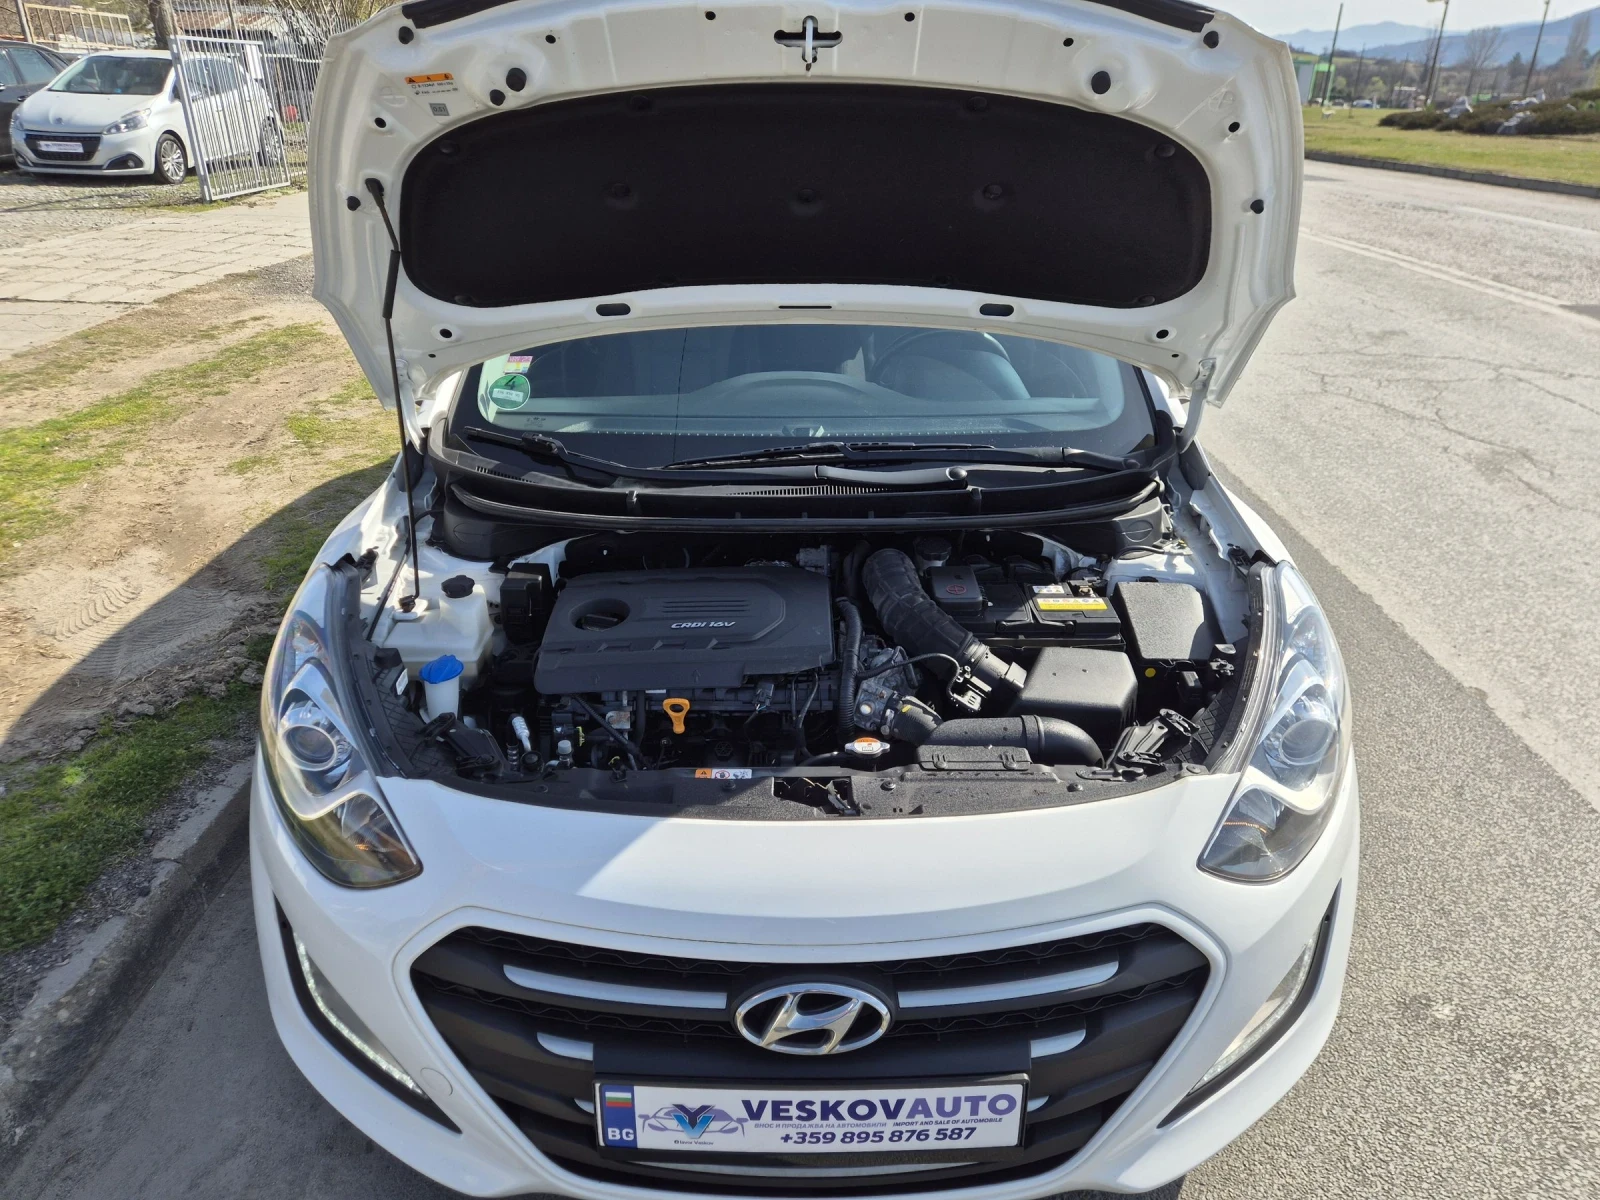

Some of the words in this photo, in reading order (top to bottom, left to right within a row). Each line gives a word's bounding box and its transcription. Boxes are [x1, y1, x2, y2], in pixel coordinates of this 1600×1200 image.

[504, 375, 516, 390] 4
[671, 621, 707, 629] CRDI
[741, 1093, 1017, 1122] VESKOVAUTO
[607, 1127, 635, 1141] BG
[780, 1131, 836, 1144] +359
[840, 1130, 885, 1144] 895
[888, 1129, 930, 1143] 876
[934, 1127, 977, 1141] 587
